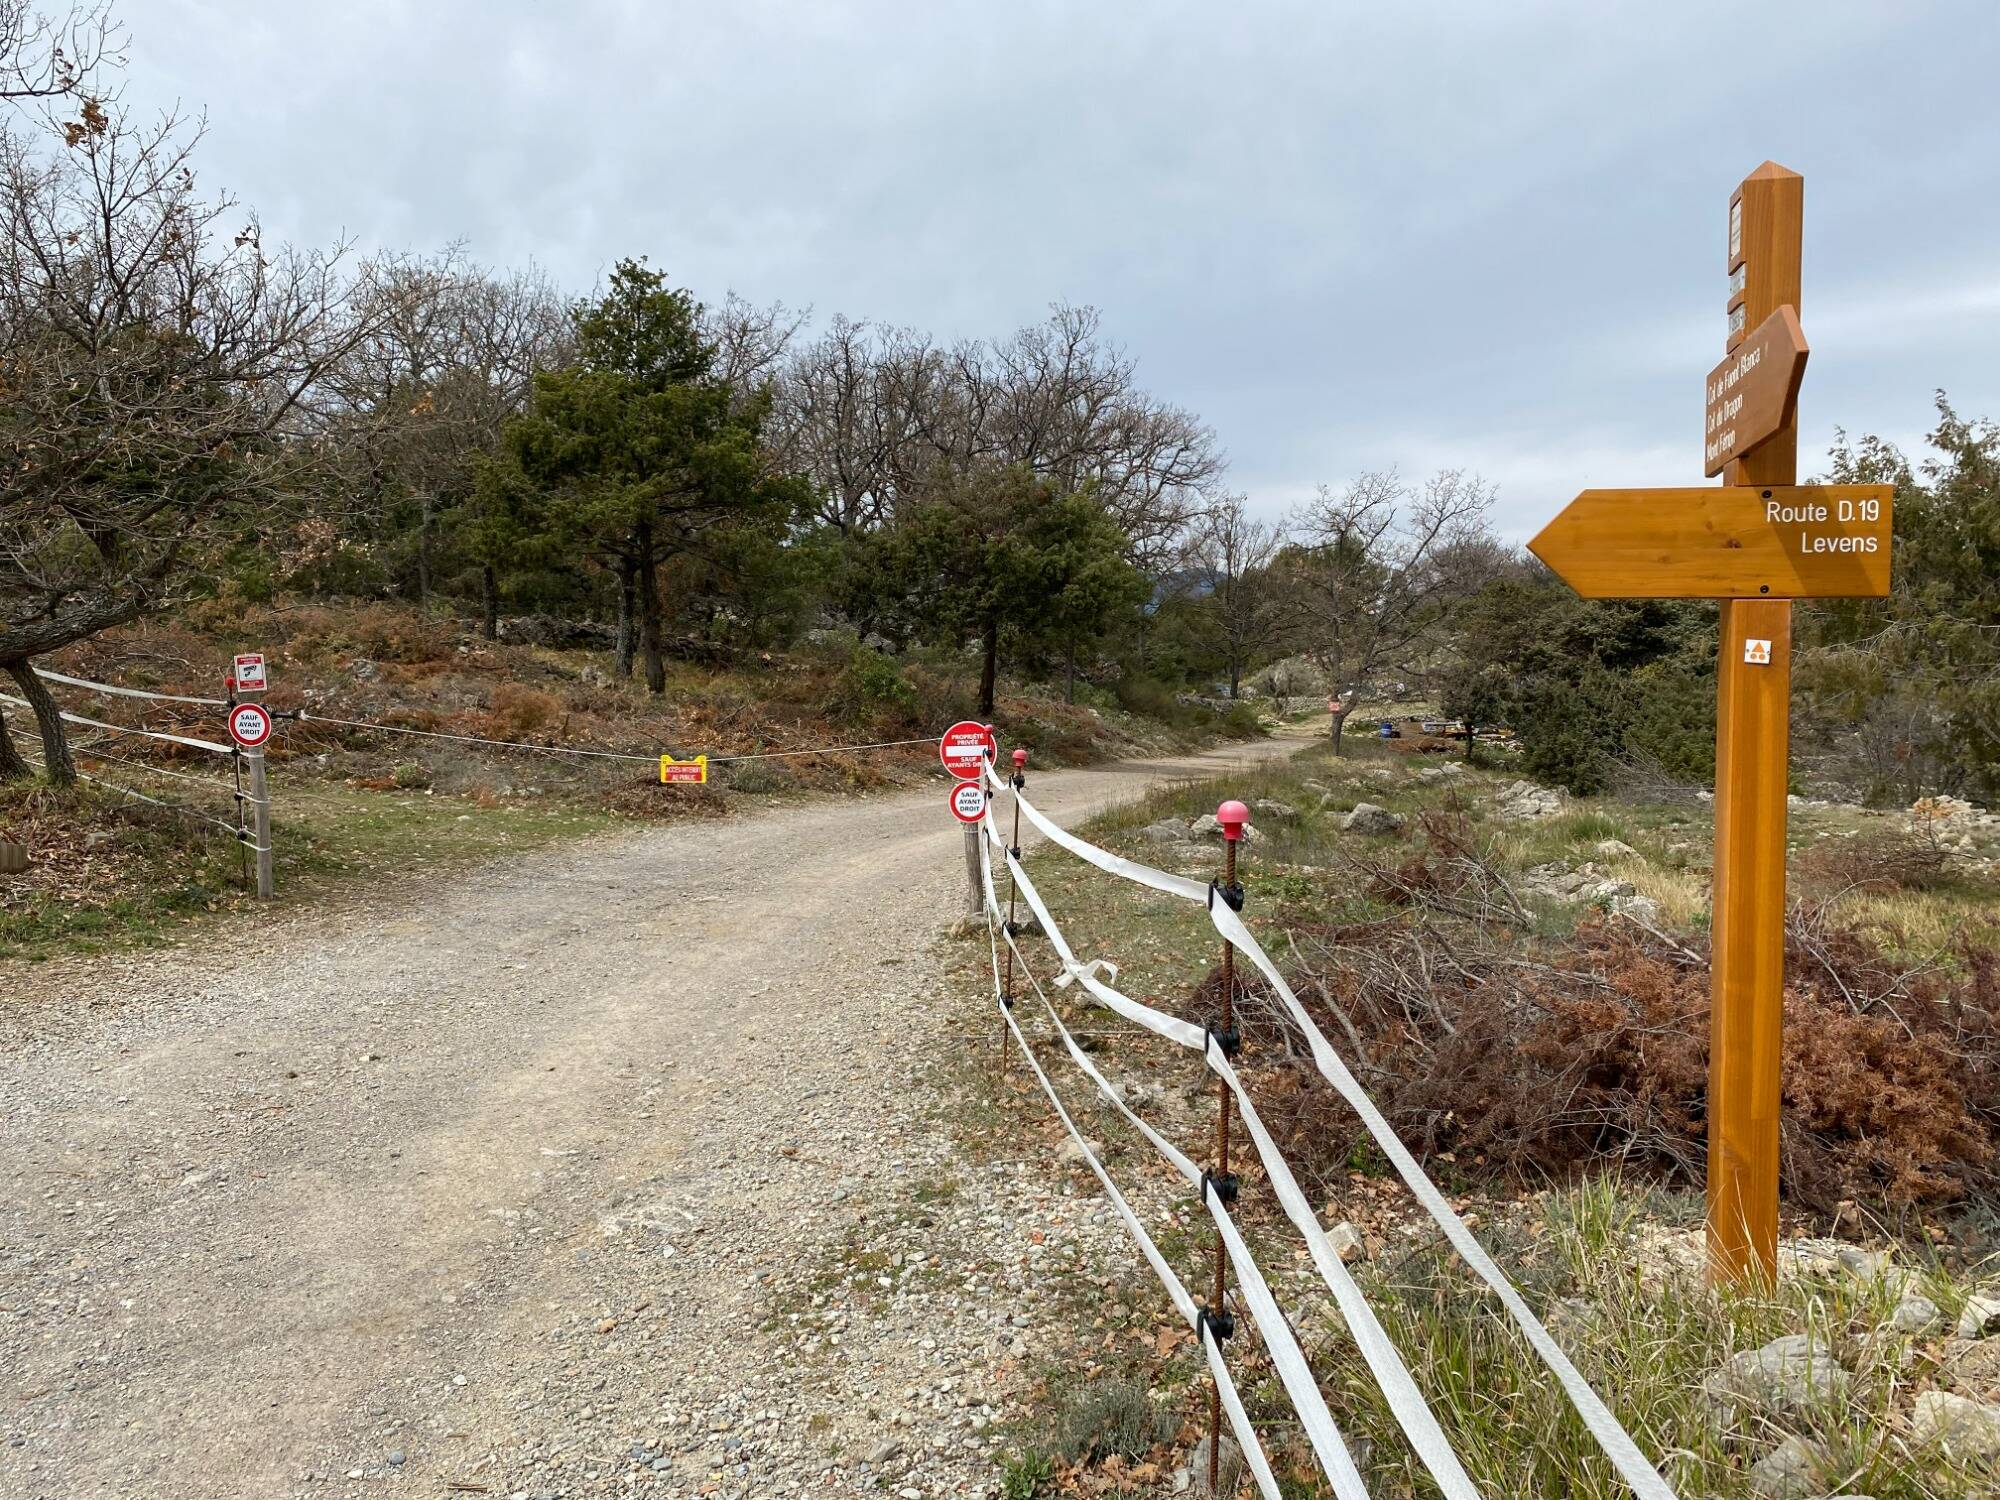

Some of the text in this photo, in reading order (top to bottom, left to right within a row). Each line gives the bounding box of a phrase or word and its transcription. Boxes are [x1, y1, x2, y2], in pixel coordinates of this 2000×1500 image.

[1707, 381, 1716, 406] Col
[1716, 377, 1724, 398] de
[1740, 347, 1761, 378] Blanca
[1707, 394, 1743, 435] Col du Dragon
[1706, 439, 1719, 463] Mont
[1766, 499, 1880, 523] Route D.19
[1801, 532, 1878, 553] Levens
